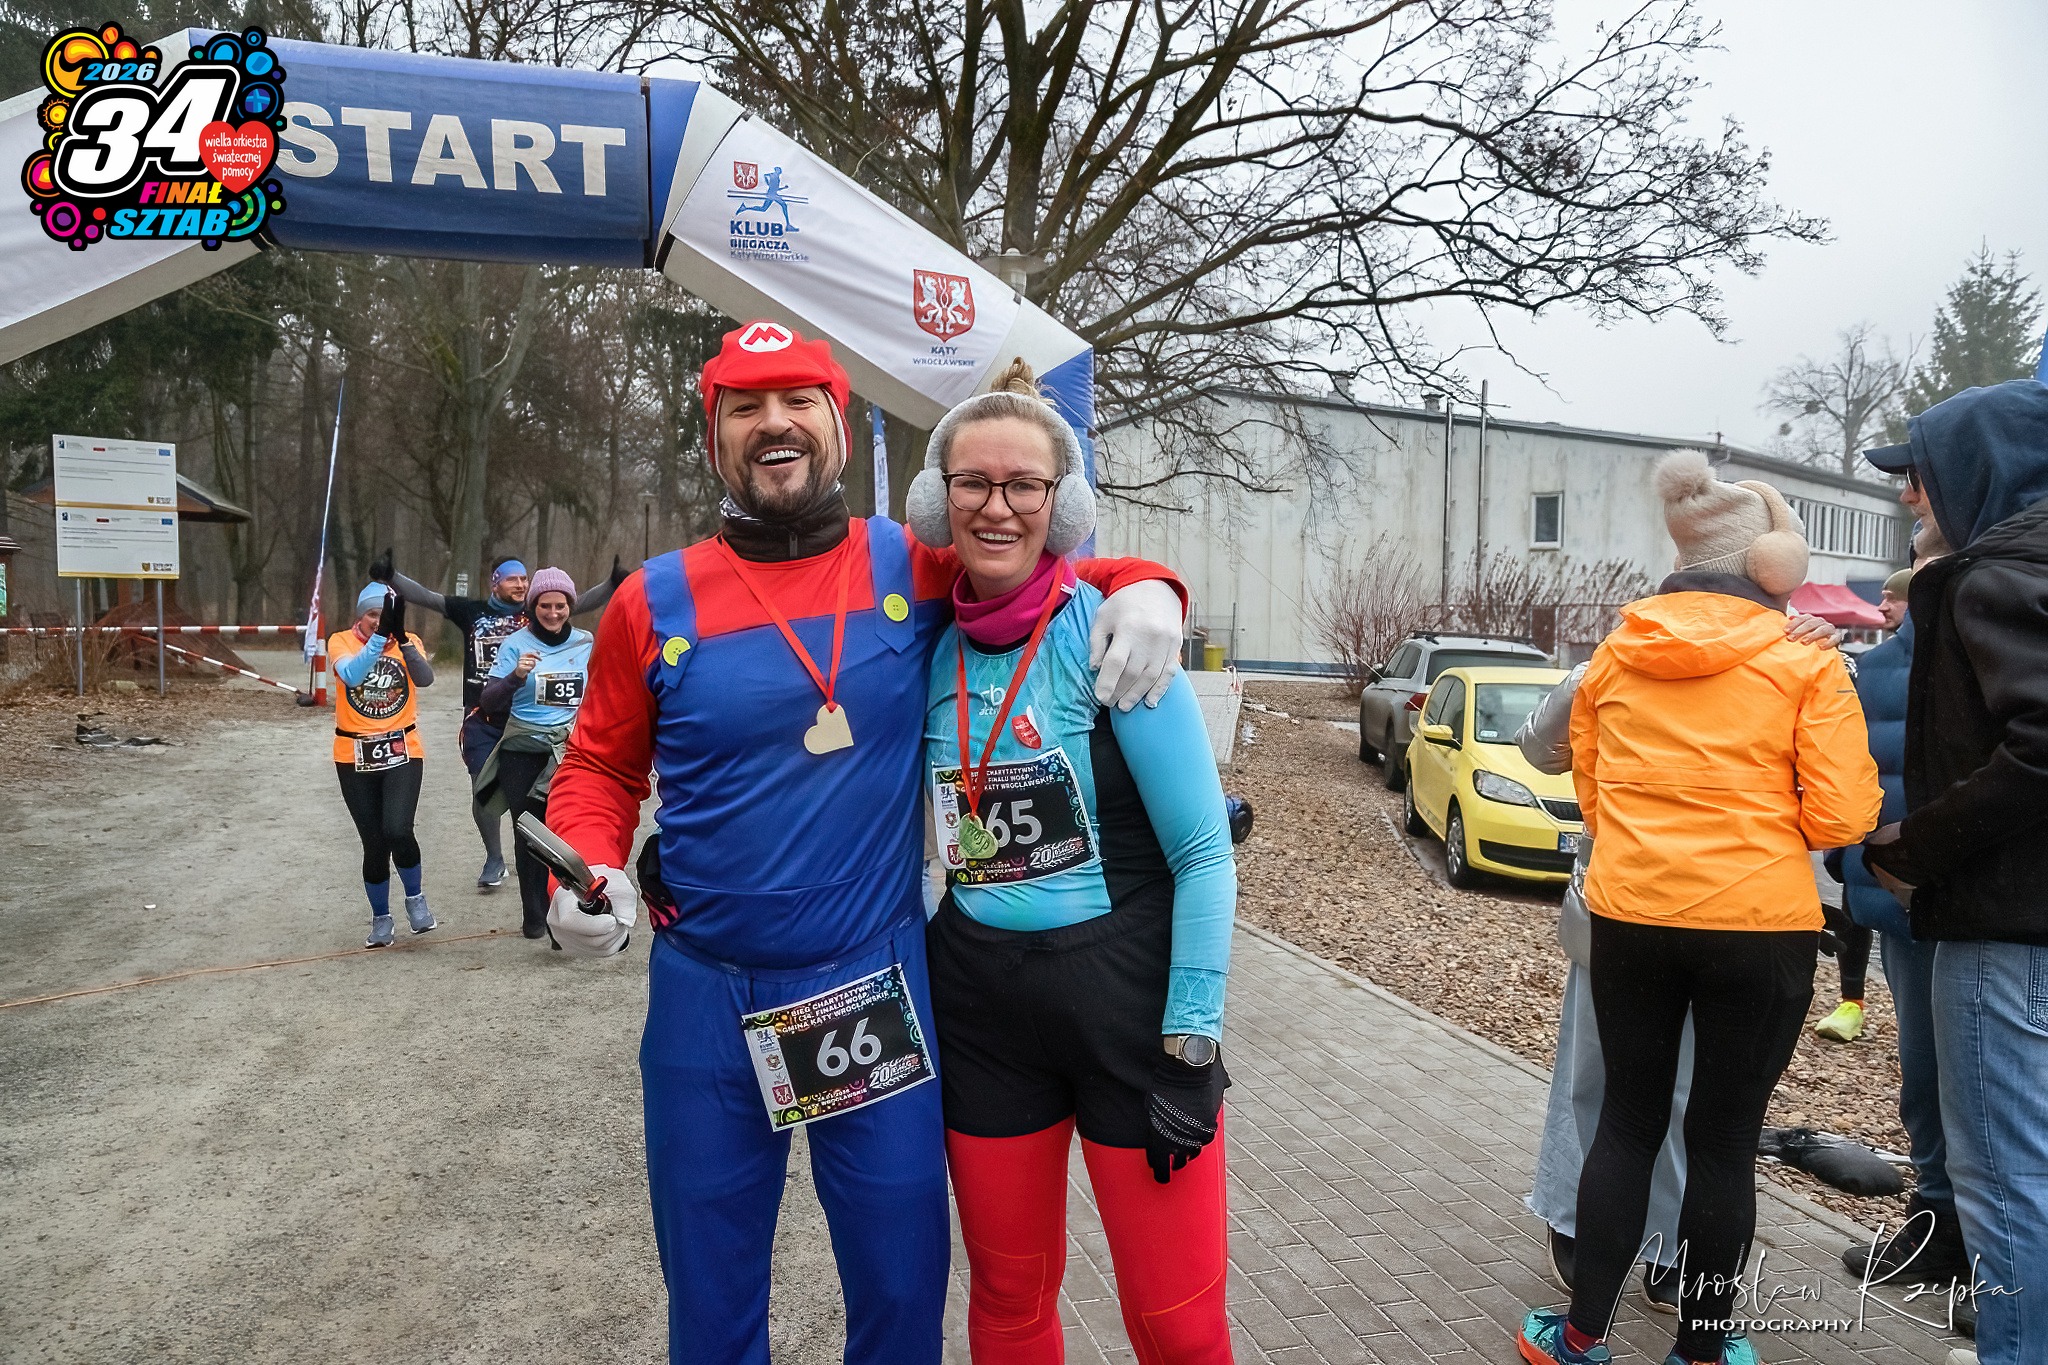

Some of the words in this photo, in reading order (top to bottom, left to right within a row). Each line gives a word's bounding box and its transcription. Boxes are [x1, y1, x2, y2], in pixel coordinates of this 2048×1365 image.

[274, 101, 627, 196] START
[730, 220, 784, 236] KLUB
[730, 238, 790, 250] BIEGACZA
[744, 326, 788, 346] M
[930, 346, 958, 356] KĄTY
[364, 673, 392, 688] 20
[554, 682, 576, 698] 35
[372, 742, 394, 758] 61
[986, 799, 1042, 848] 65
[1030, 848, 1052, 866] 20
[791, 1006, 810, 1016] BIEG
[812, 981, 875, 1010] CHARYTATYWNY
[782, 1022, 810, 1033] GMINA
[816, 1017, 882, 1077] 66
[869, 1066, 890, 1088] 20
